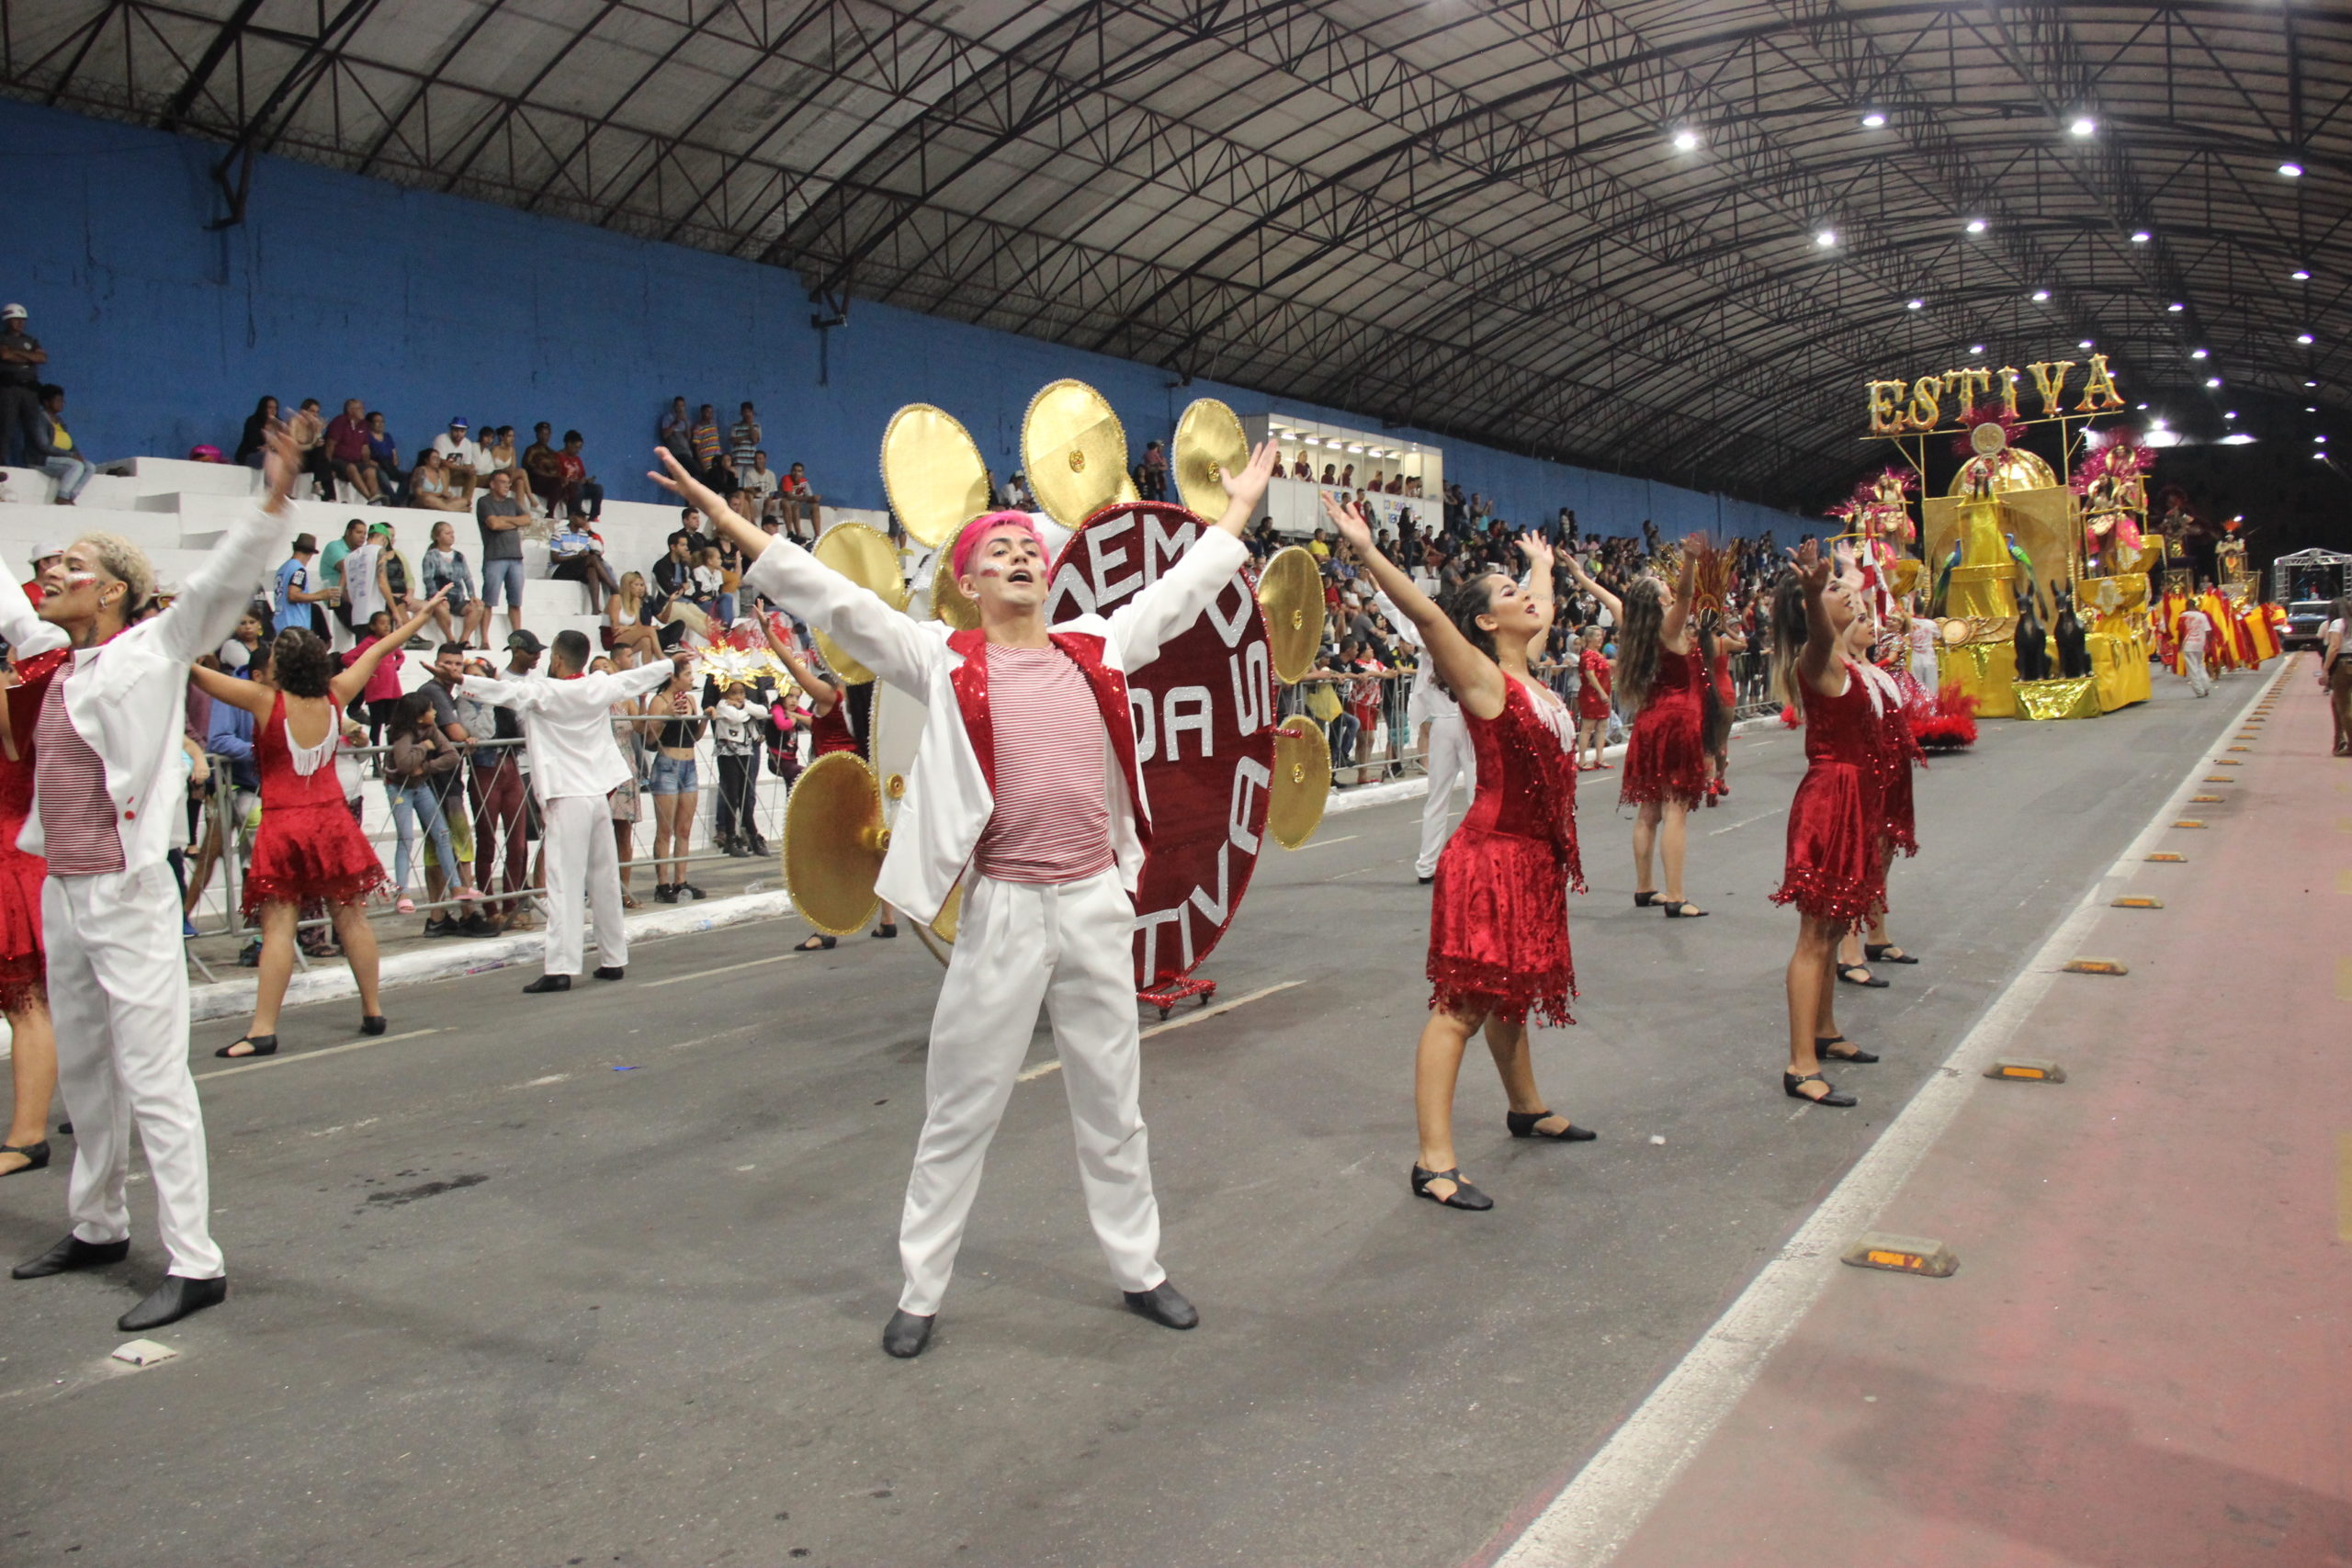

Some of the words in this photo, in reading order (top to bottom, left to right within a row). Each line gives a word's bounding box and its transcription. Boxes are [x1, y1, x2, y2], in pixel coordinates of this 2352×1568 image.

[1864, 354, 2125, 433] ESTIVA
[1128, 685, 1214, 763] DA
[1134, 755, 1271, 988] TIVA
